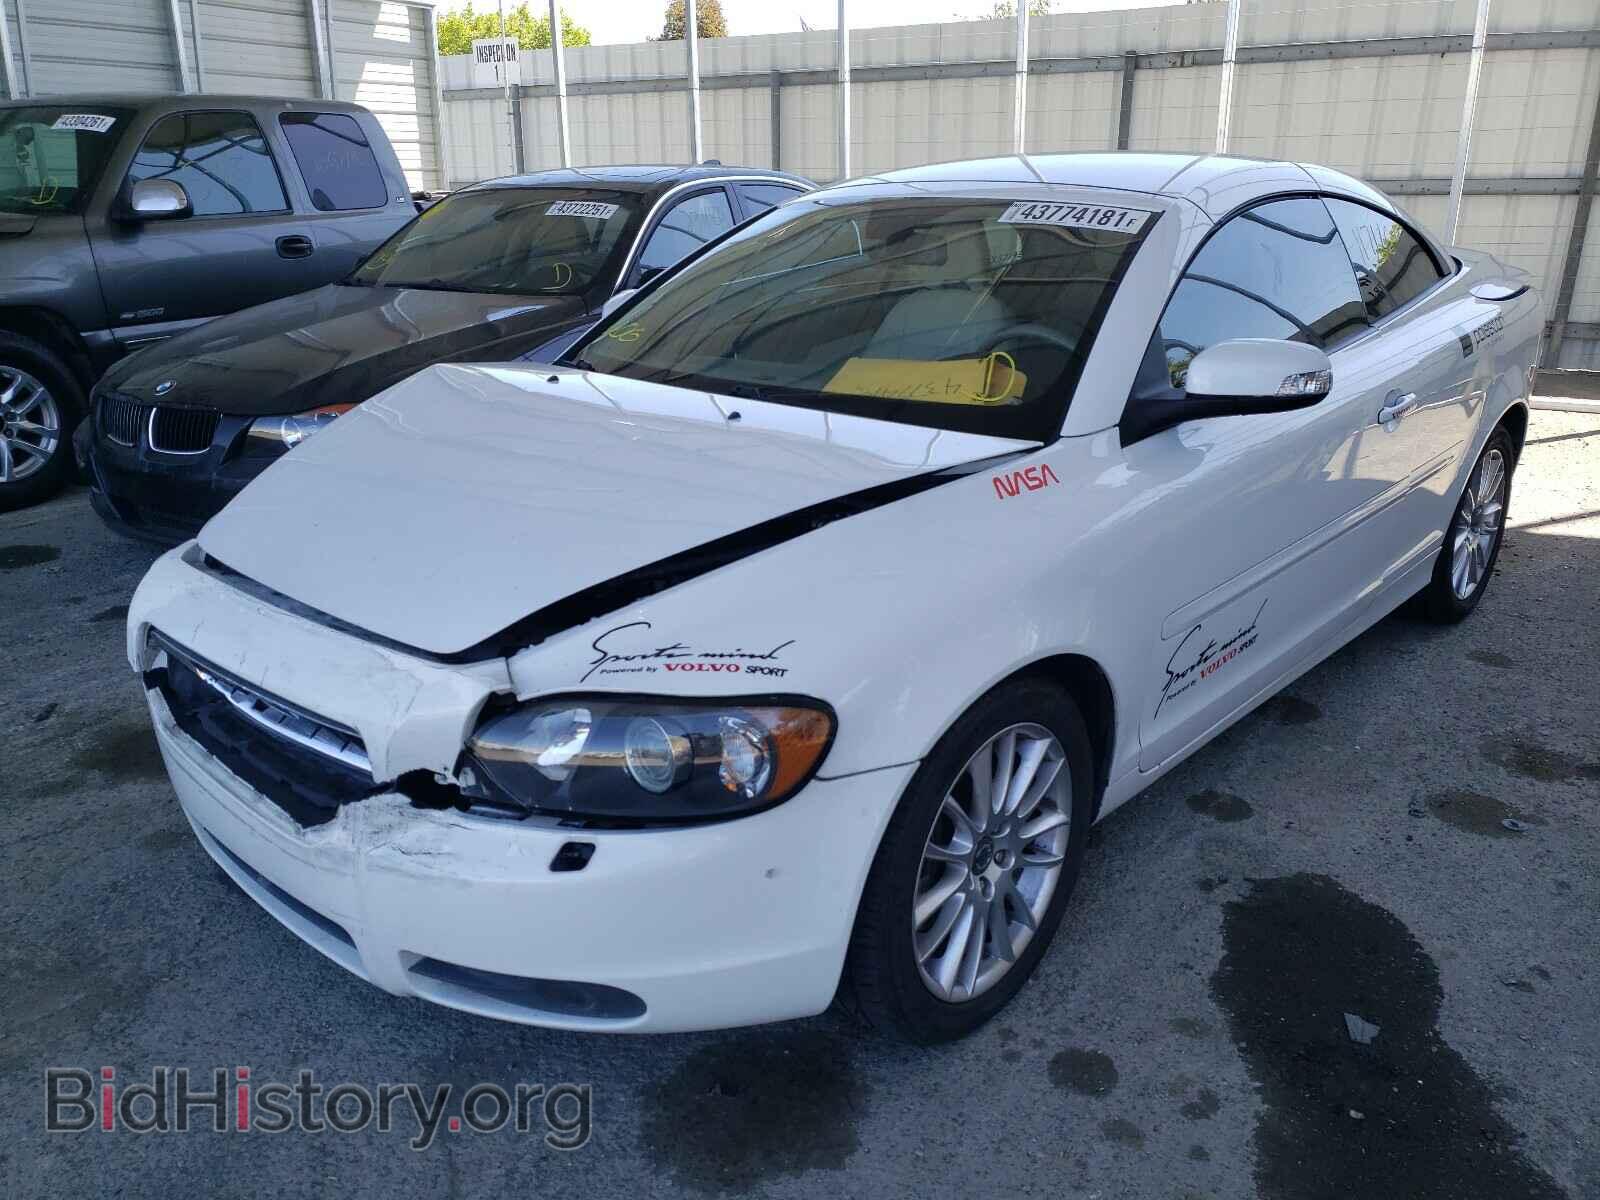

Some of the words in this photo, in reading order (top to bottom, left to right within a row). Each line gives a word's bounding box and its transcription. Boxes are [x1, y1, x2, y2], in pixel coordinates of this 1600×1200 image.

[476, 43, 516, 64] INSPECTON
[1021, 203, 1129, 228] 43774181
[993, 464, 1060, 500] NASA
[664, 663, 741, 674] VOLVO
[745, 664, 788, 678] SPORT
